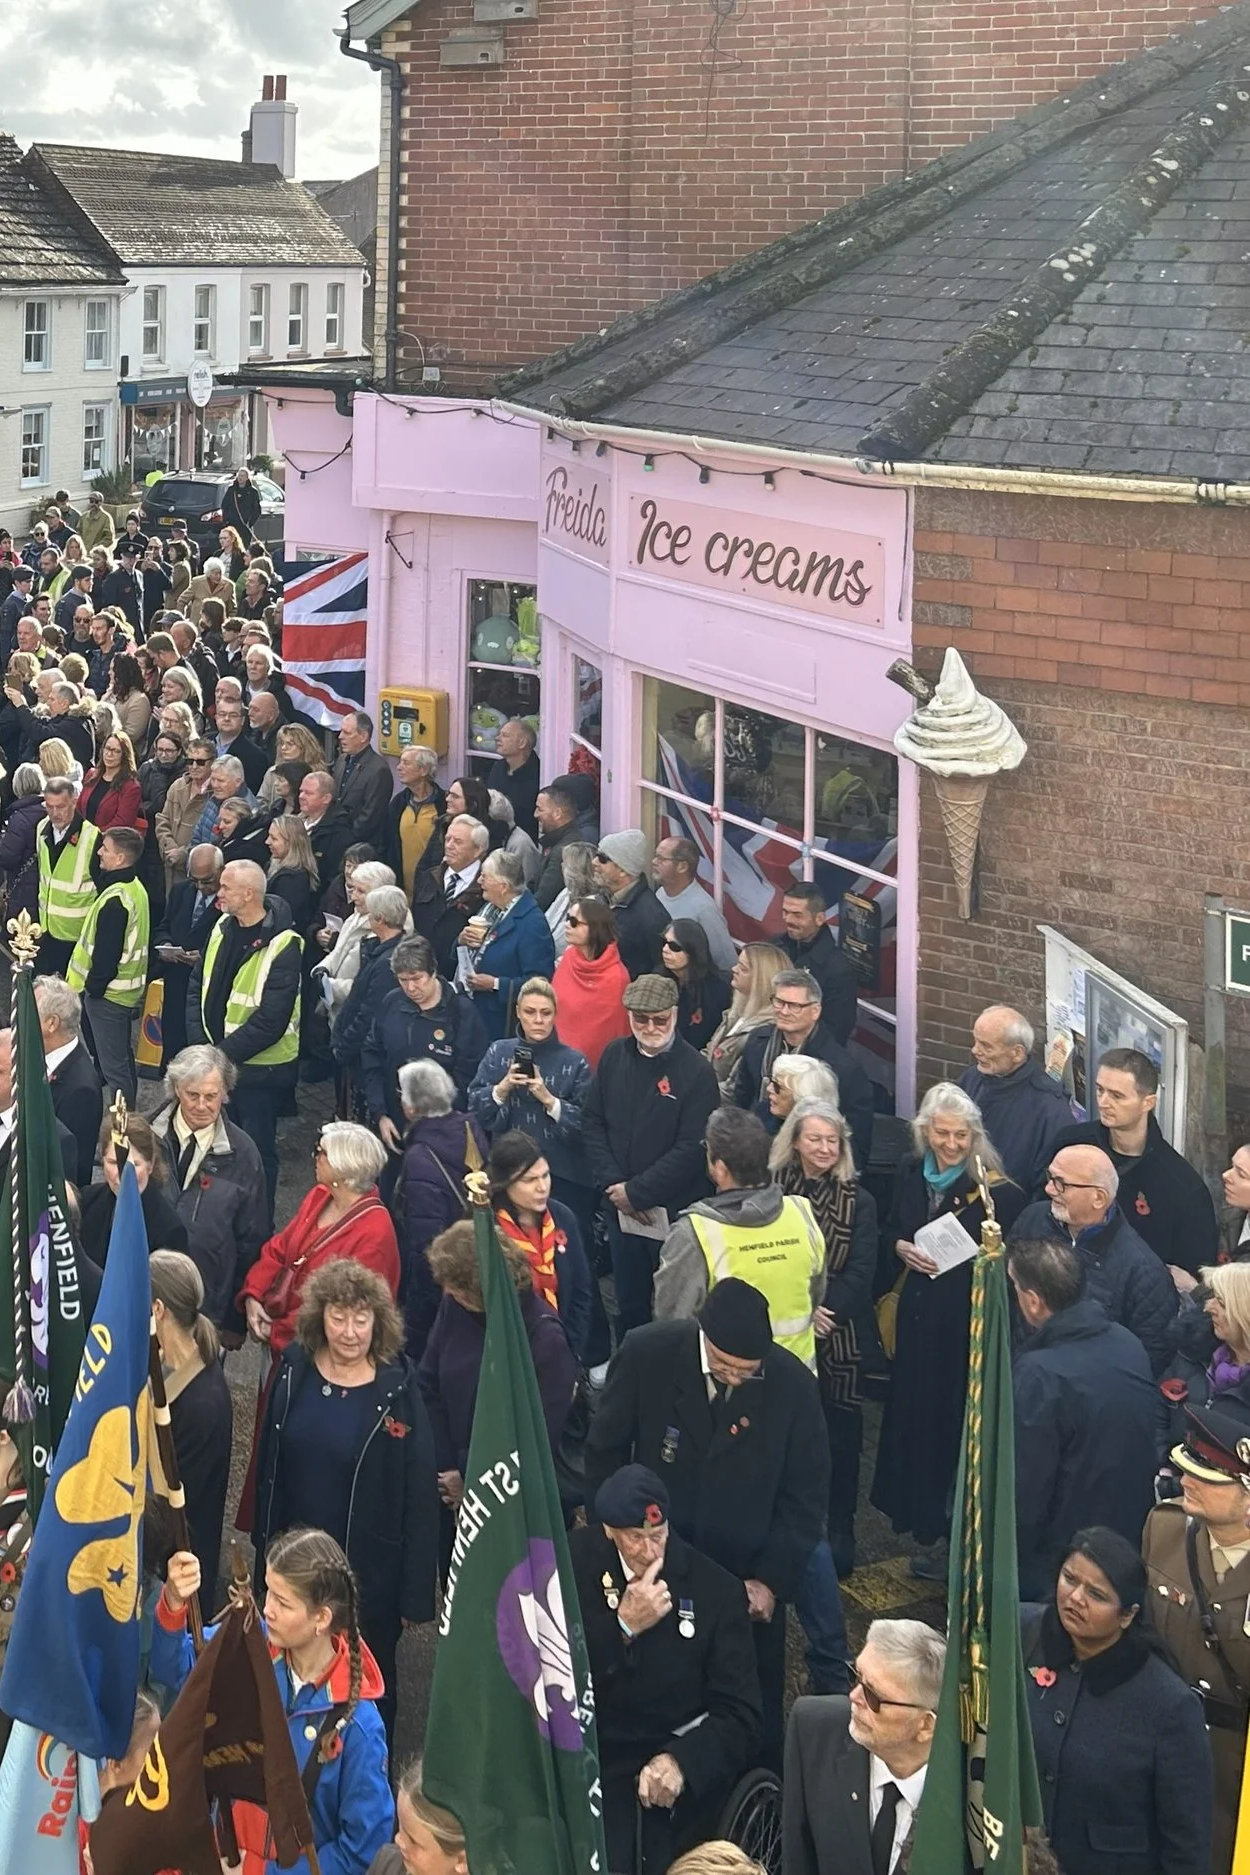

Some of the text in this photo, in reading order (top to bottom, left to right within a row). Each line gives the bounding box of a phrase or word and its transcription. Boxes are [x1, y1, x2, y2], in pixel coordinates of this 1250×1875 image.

[546, 466, 608, 548] Freida
[636, 500, 872, 606] Ice creams
[739, 1238, 800, 1252] HENFIELD PARISH
[757, 1254, 787, 1263] COUNCIL
